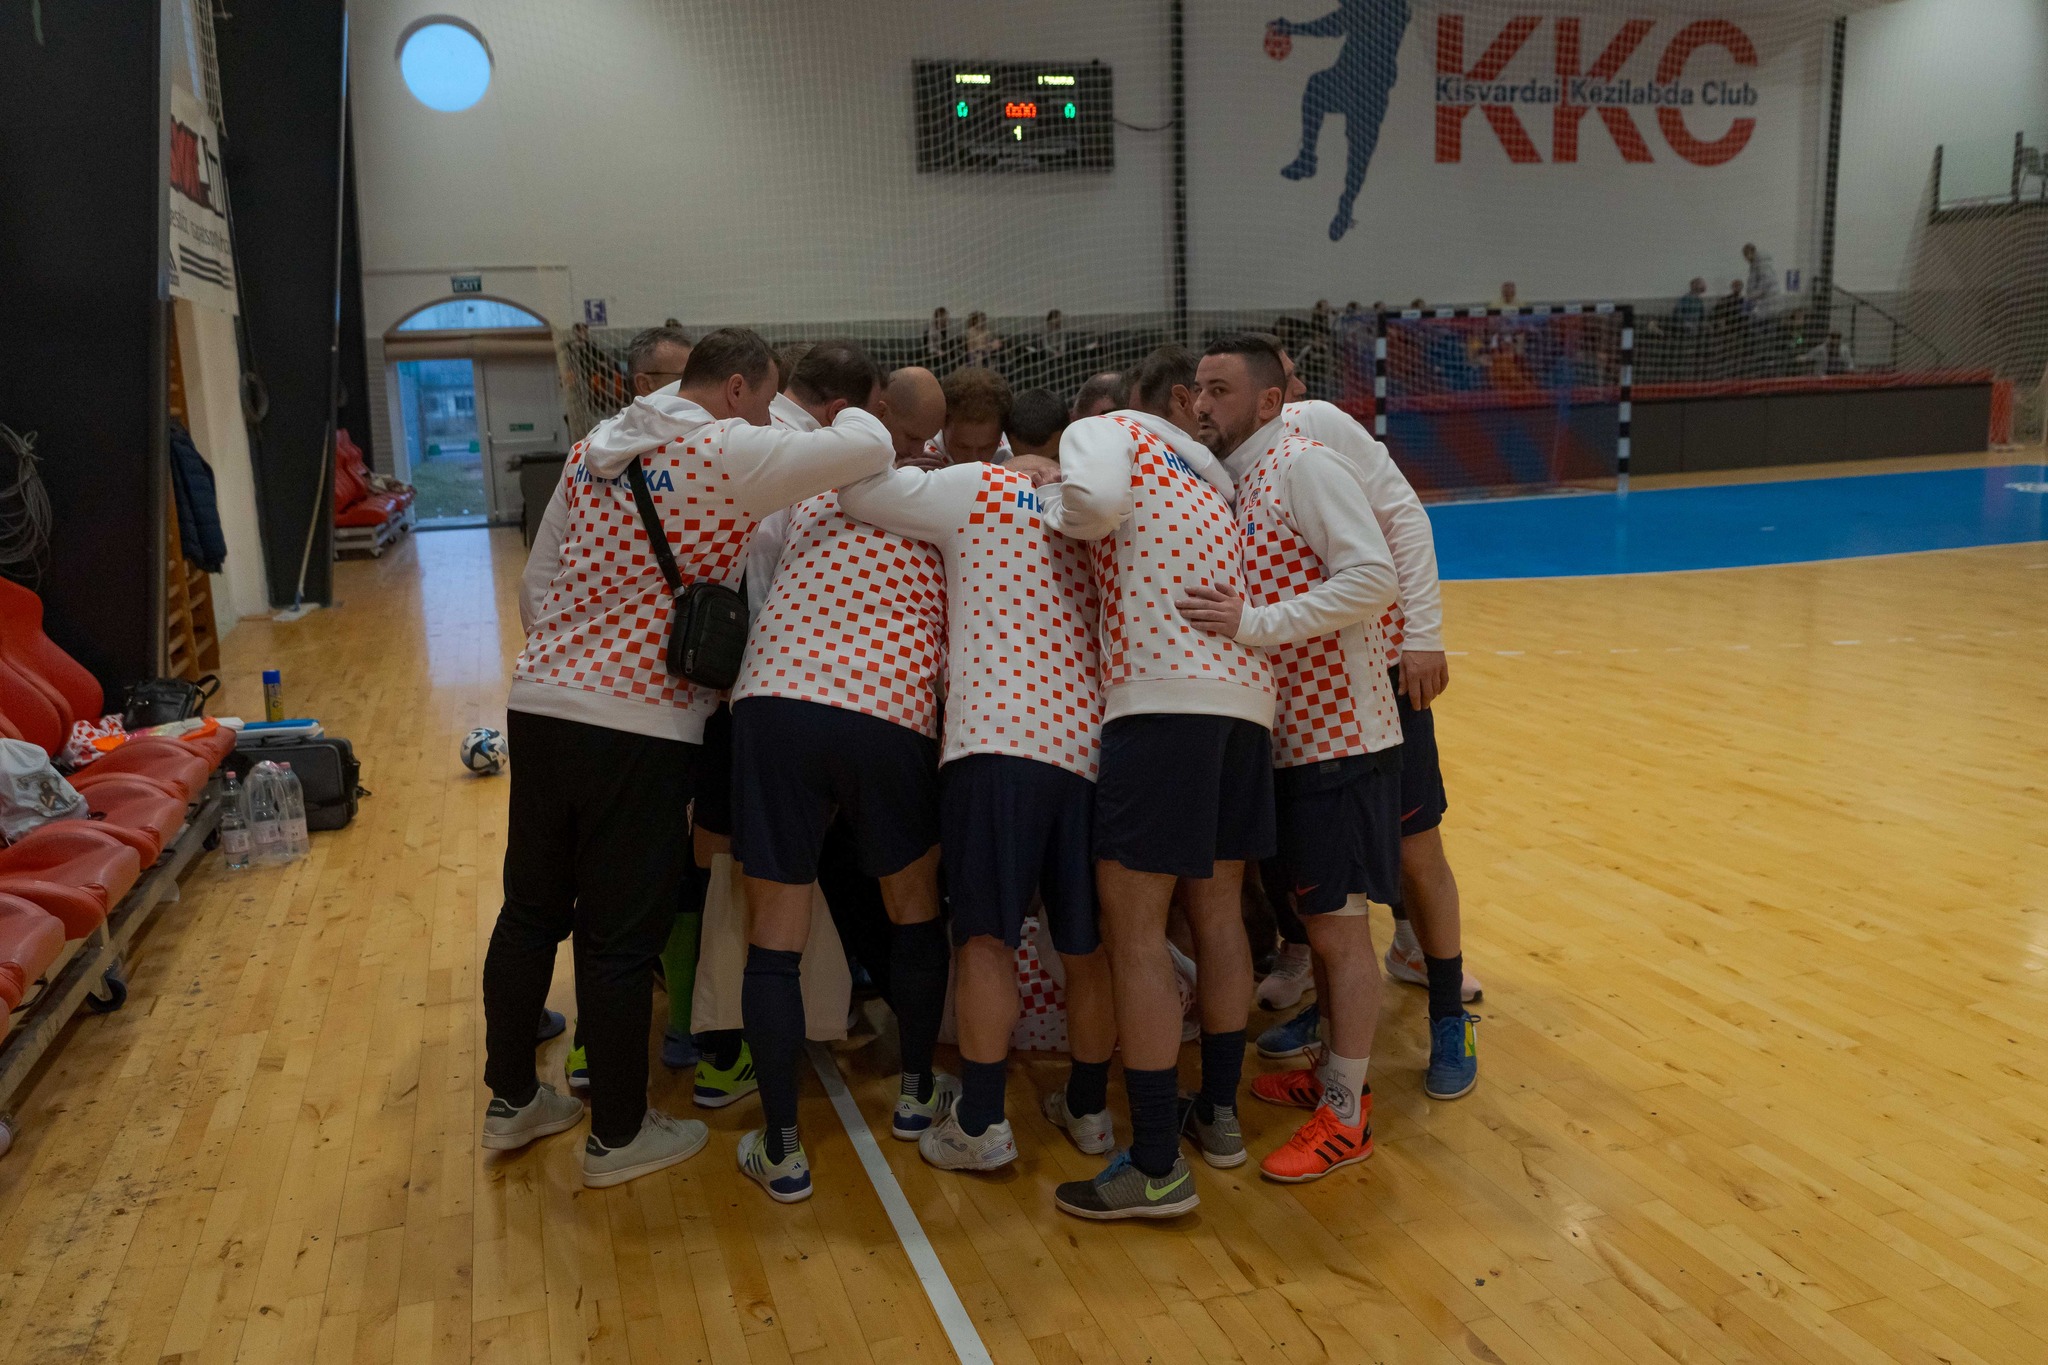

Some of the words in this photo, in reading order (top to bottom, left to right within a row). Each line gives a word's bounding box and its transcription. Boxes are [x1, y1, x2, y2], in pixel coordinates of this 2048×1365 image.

[1434, 13, 1758, 167] KKC
[1702, 79, 1758, 107] Club
[1064, 102, 1076, 118] 0
[1013, 125, 1022, 141] 1
[454, 281, 479, 292] EXIT
